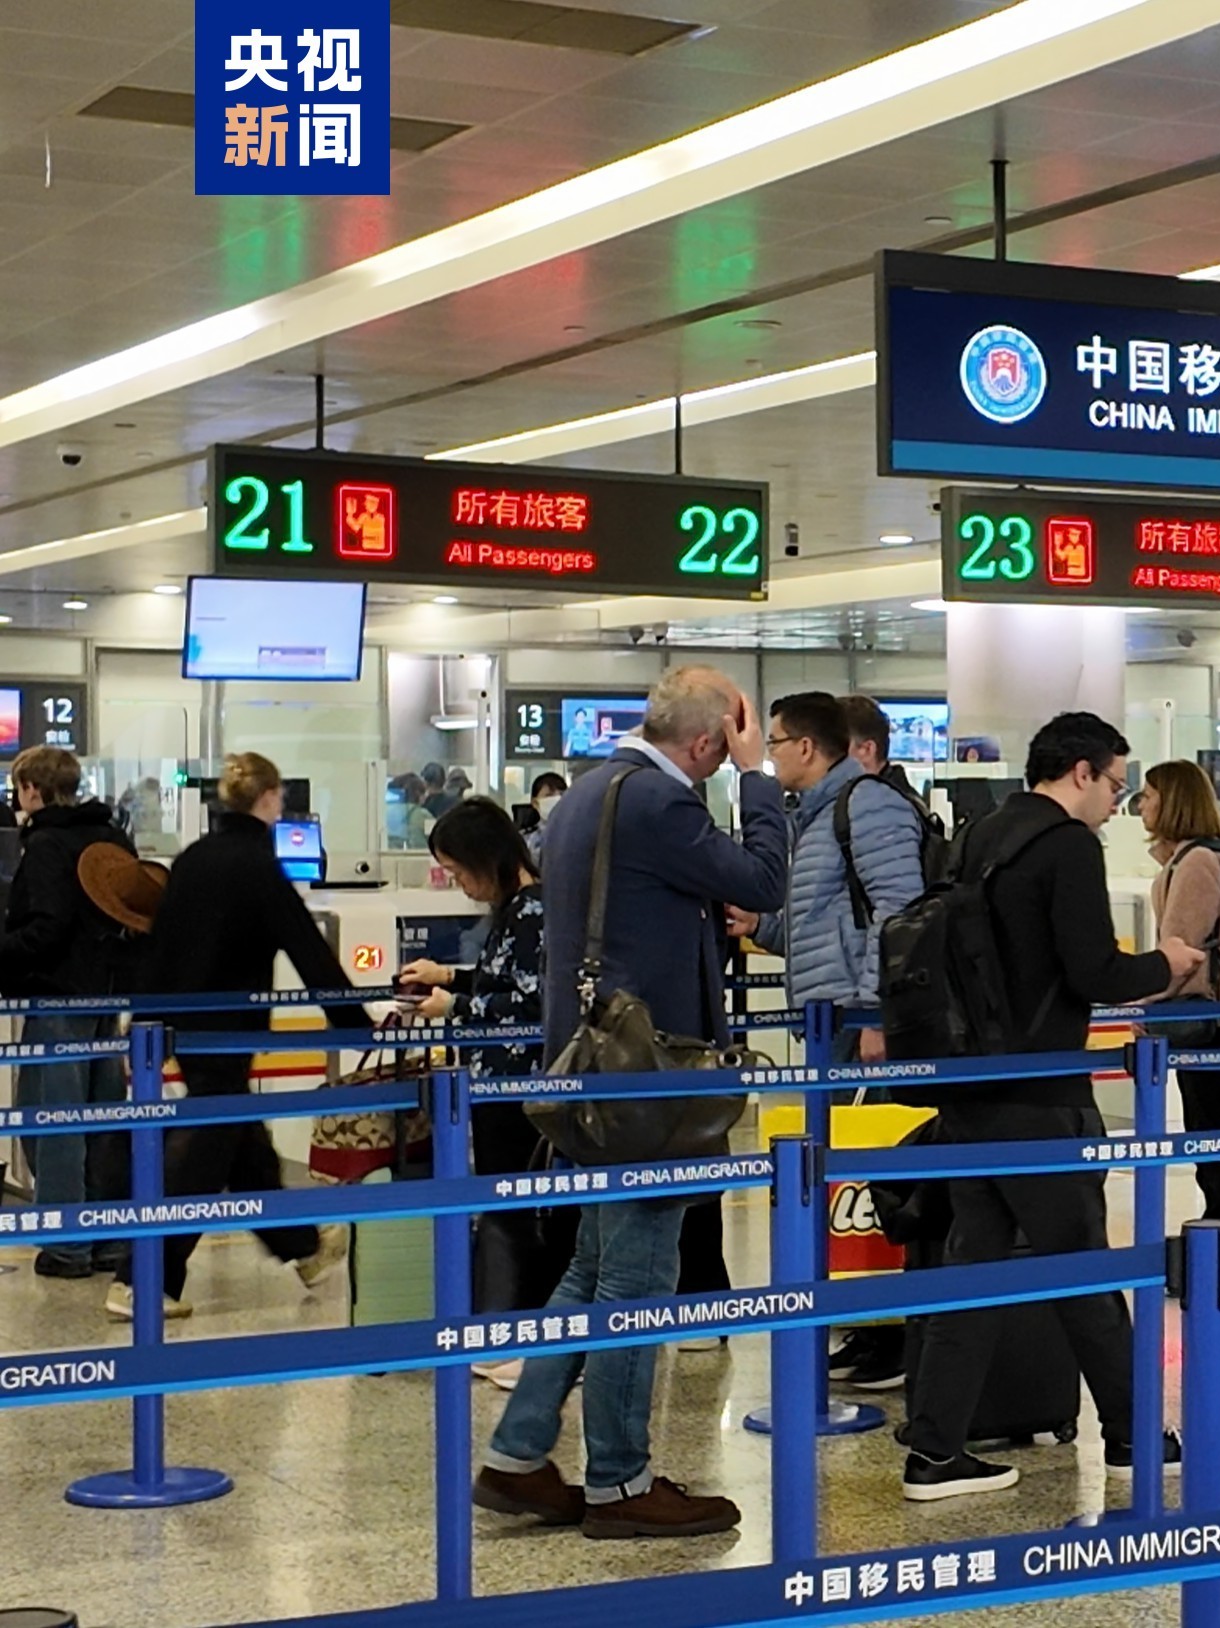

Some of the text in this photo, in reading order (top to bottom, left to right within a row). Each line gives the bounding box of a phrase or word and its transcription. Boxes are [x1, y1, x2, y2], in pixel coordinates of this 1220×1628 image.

[1089, 400, 1174, 431] CHINA
[225, 476, 314, 552] 21
[456, 490, 588, 530] 所有旅客
[679, 506, 759, 574] 22
[960, 515, 1034, 580] 23
[448, 544, 594, 572] All Passengers
[43, 698, 73, 723] 12
[517, 704, 544, 728] 13
[355, 947, 384, 970] 21
[469, 1077, 583, 1095] HINA IMMIGRATION
[827, 1063, 936, 1081] CHINA IMMIGRATION
[35, 1104, 177, 1125] CHINA IMMIGRATION
[1082, 1140, 1174, 1162] 中国移民管理
[495, 1172, 608, 1198] 中国移民管理
[621, 1159, 774, 1187] CHINA IMMIGRATION
[78, 1199, 263, 1228] CHINA IMMIGRATION
[831, 1186, 883, 1232] LE
[607, 1291, 814, 1332] CHINA IMMIGRATION
[436, 1313, 590, 1351] 中国移民管理
[0, 1359, 116, 1390] GRATION
[1023, 1538, 1114, 1576] CHINA
[784, 1548, 997, 1606] 中国移民管理
